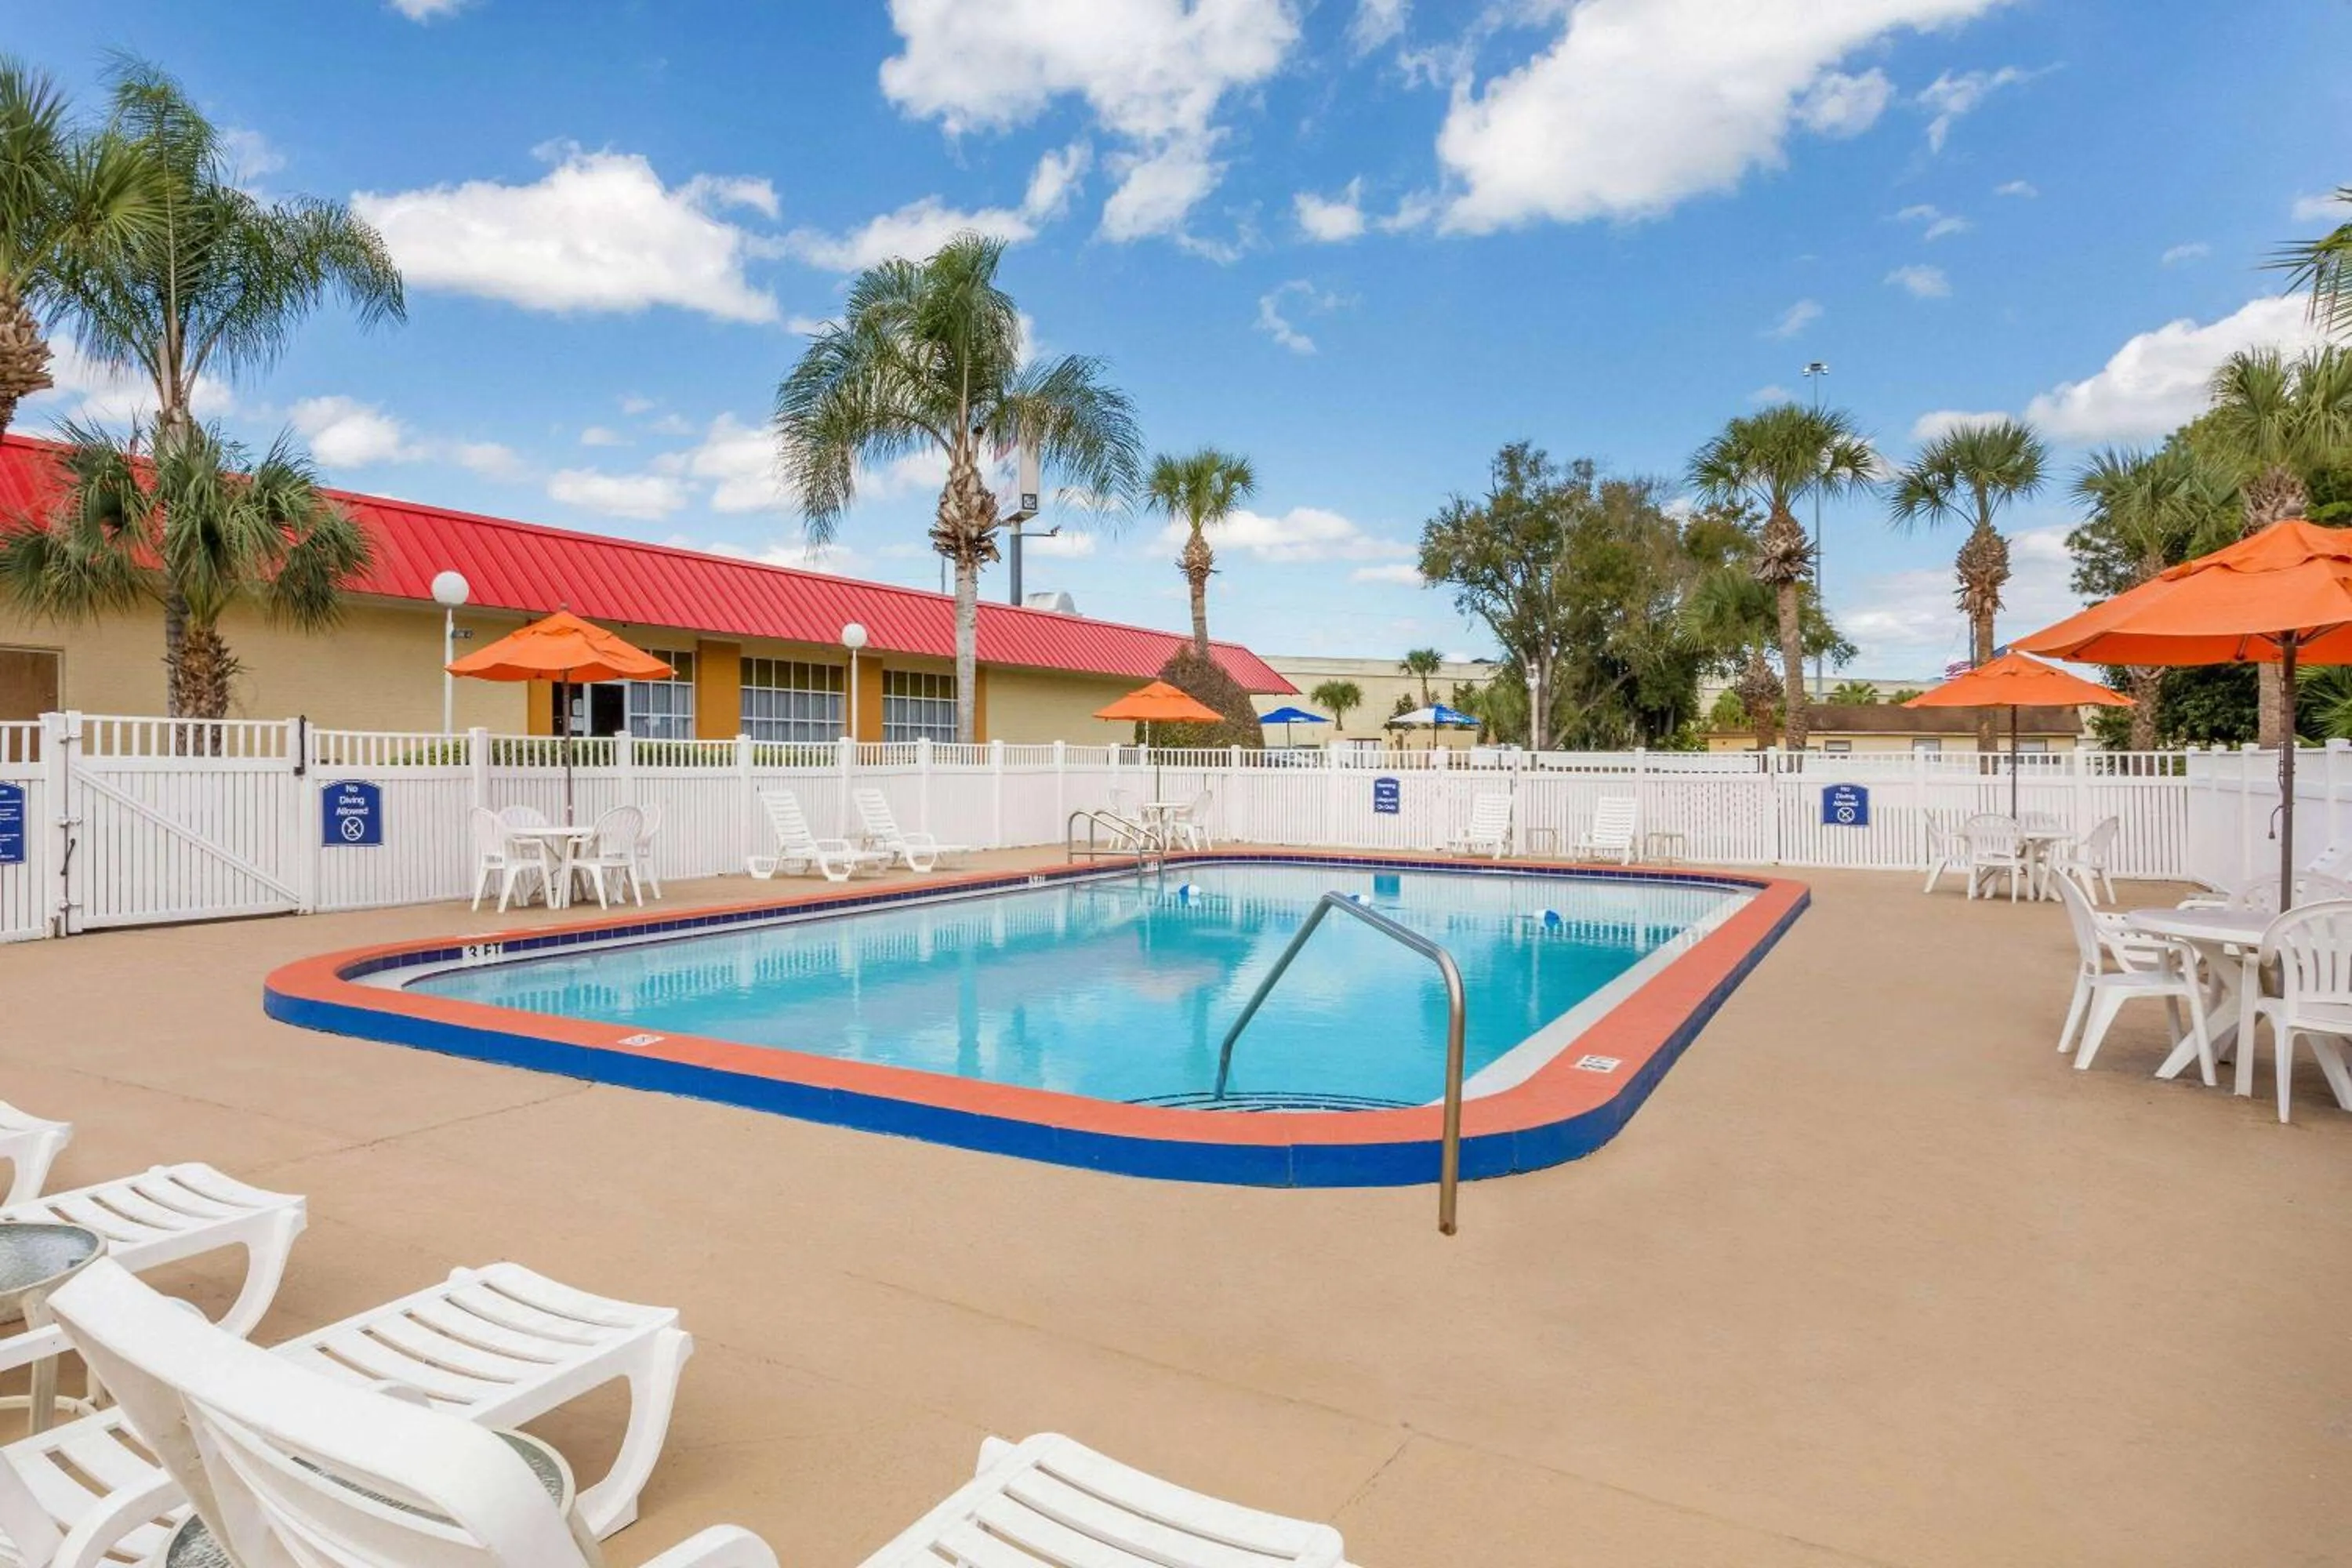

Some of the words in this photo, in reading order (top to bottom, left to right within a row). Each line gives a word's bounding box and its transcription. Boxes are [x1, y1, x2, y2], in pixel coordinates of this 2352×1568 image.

[346, 784, 358, 793] No
[339, 796, 365, 806] Diving
[336, 807, 369, 816] Allowed
[469, 945, 477, 957] 3
[484, 942, 501, 956] FT
